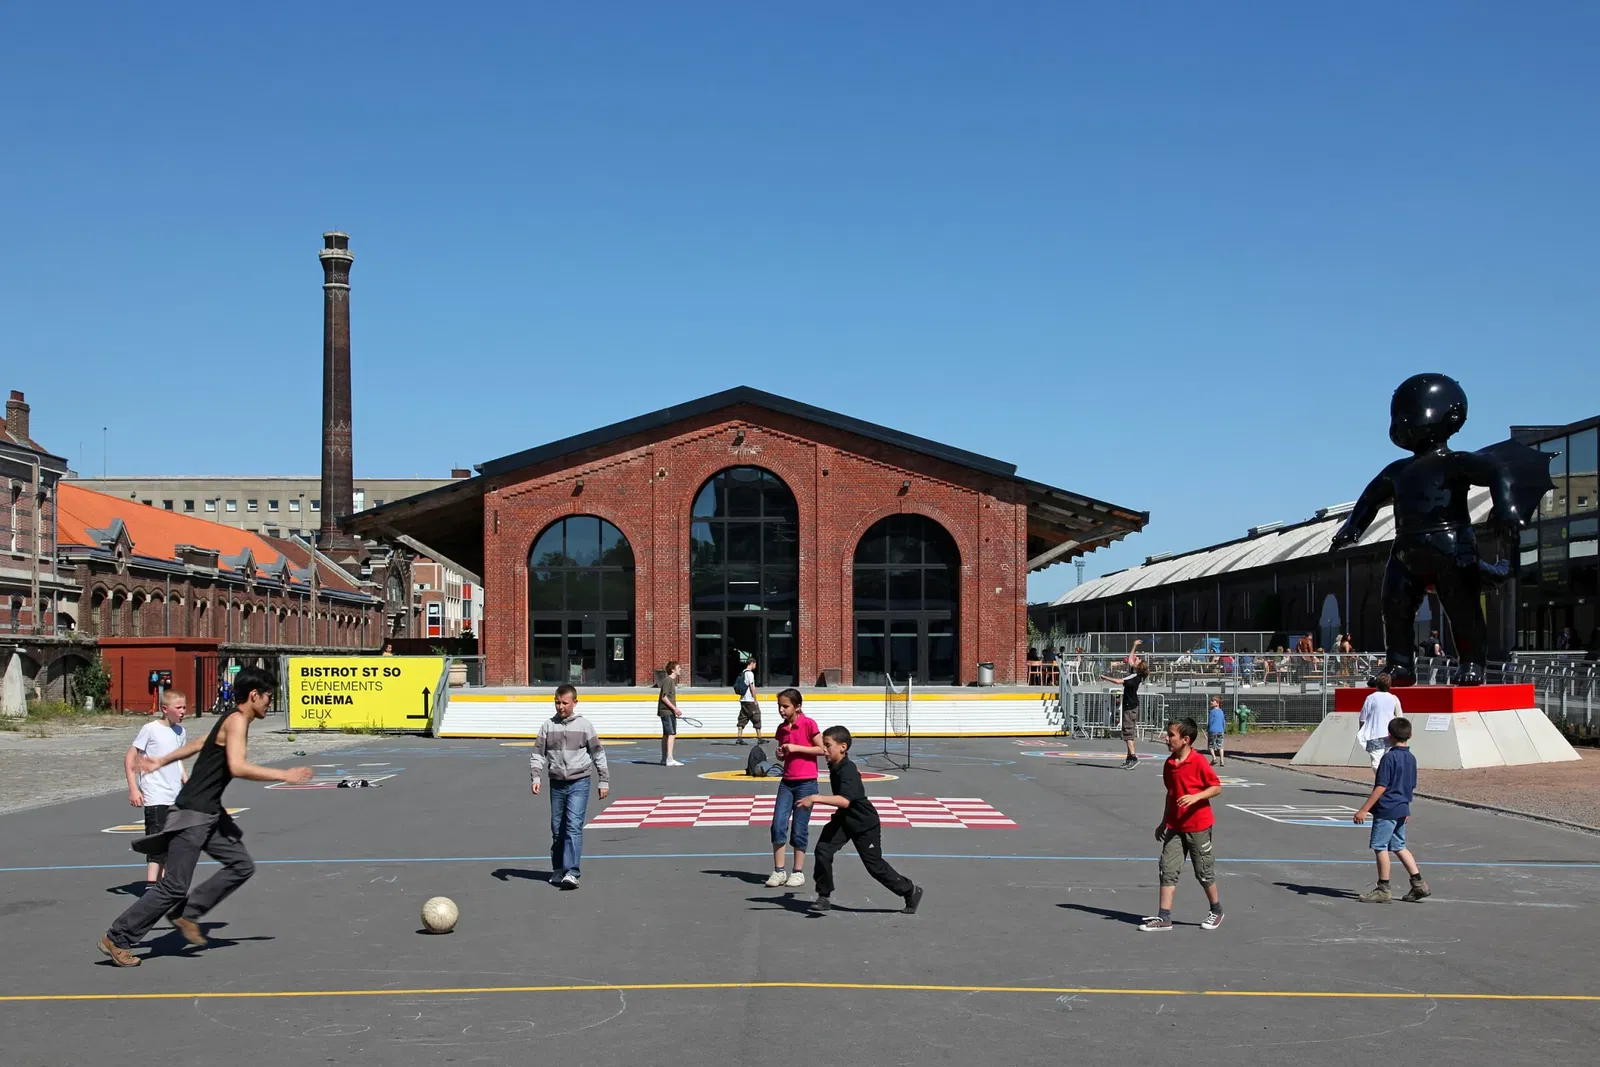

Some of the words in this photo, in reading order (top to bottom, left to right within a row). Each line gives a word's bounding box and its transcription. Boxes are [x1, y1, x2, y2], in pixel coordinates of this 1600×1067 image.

[301, 667, 358, 677] BISTROT
[362, 667, 379, 677] ST
[383, 667, 401, 677] SO
[301, 679, 383, 691] ÉVÉNEMENTS
[301, 693, 353, 705] CINÉMA
[301, 709, 332, 719] JEUX
